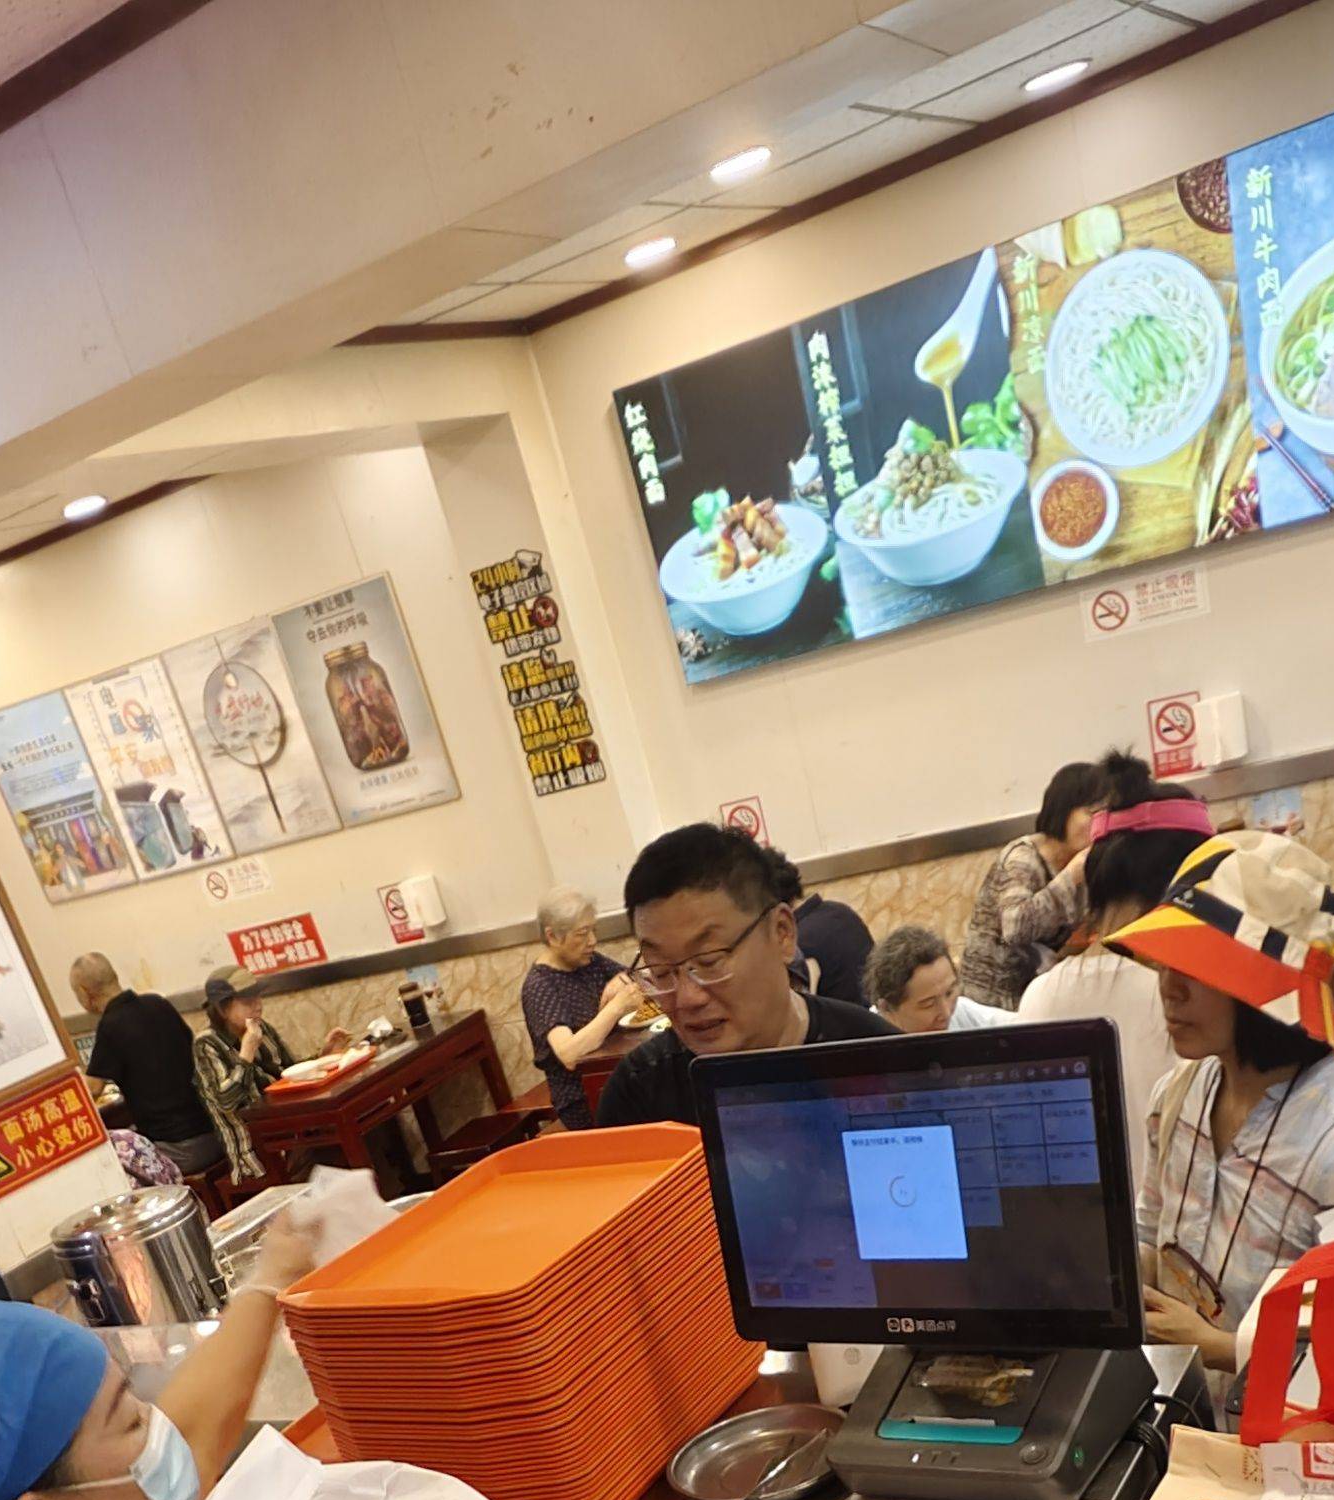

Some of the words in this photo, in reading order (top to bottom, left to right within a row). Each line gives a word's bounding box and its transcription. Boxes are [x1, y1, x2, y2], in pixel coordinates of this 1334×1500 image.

[1, 1090, 84, 1140] 面汤高温
[14, 1117, 95, 1173] 小心烫伤
